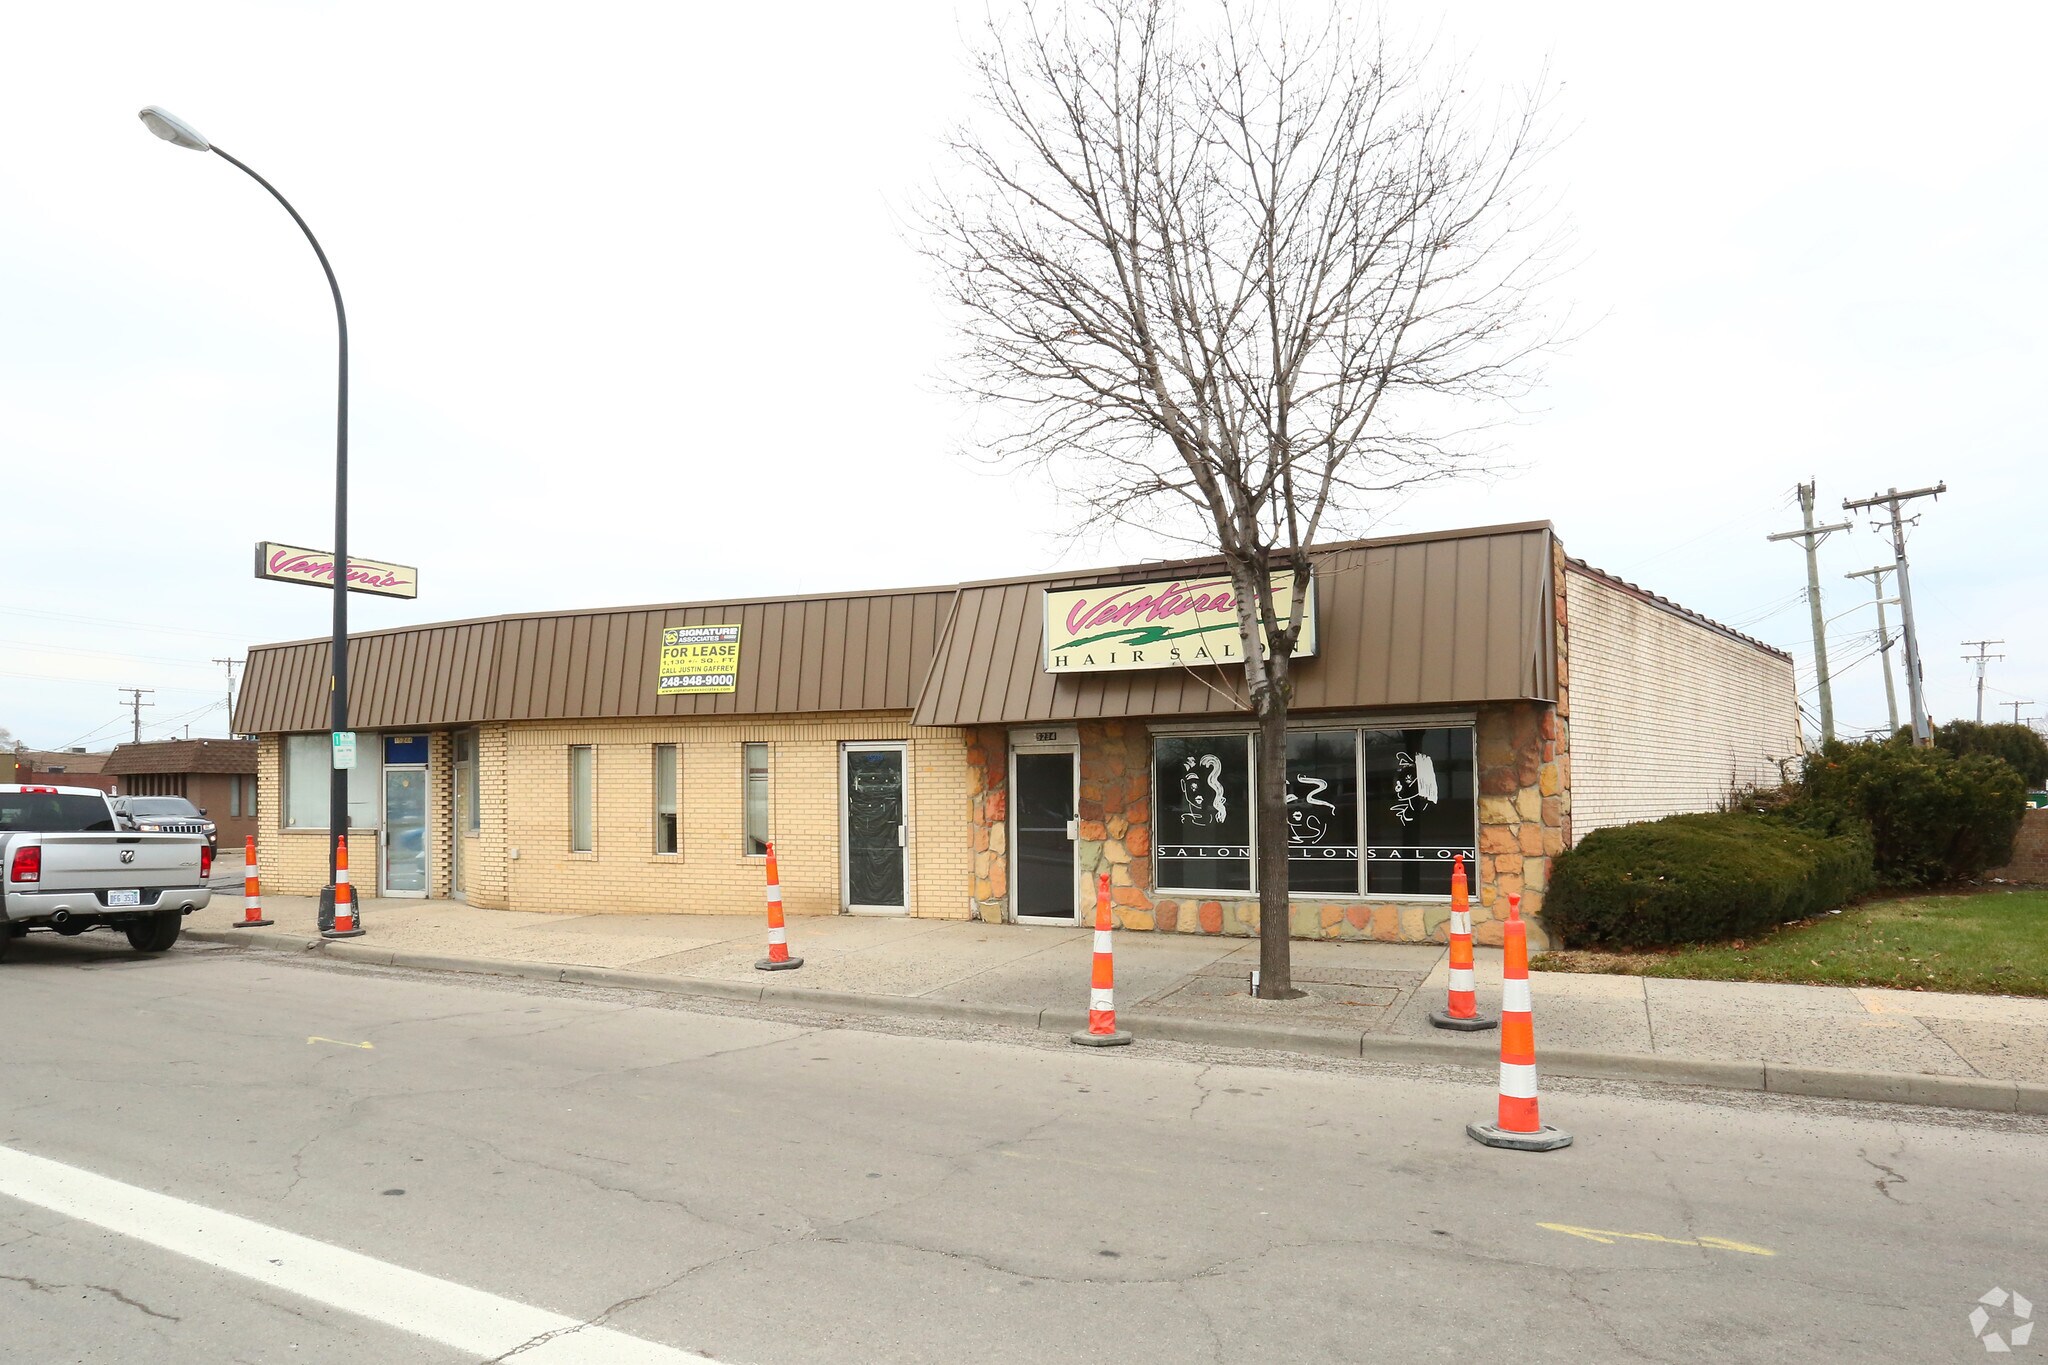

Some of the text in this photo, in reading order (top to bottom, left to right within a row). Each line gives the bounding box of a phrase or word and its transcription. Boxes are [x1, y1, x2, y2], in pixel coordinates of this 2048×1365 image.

[1066, 580, 1287, 636] Ventura
[679, 628, 738, 637] SIGNATURE
[663, 645, 736, 658] FOR LEASE
[1055, 650, 1145, 667] HAIR
[661, 675, 733, 688] 248-948-9000
[1158, 847, 1250, 857] SALON
[1302, 848, 1358, 858] LON
[1367, 849, 1475, 859] SALON
